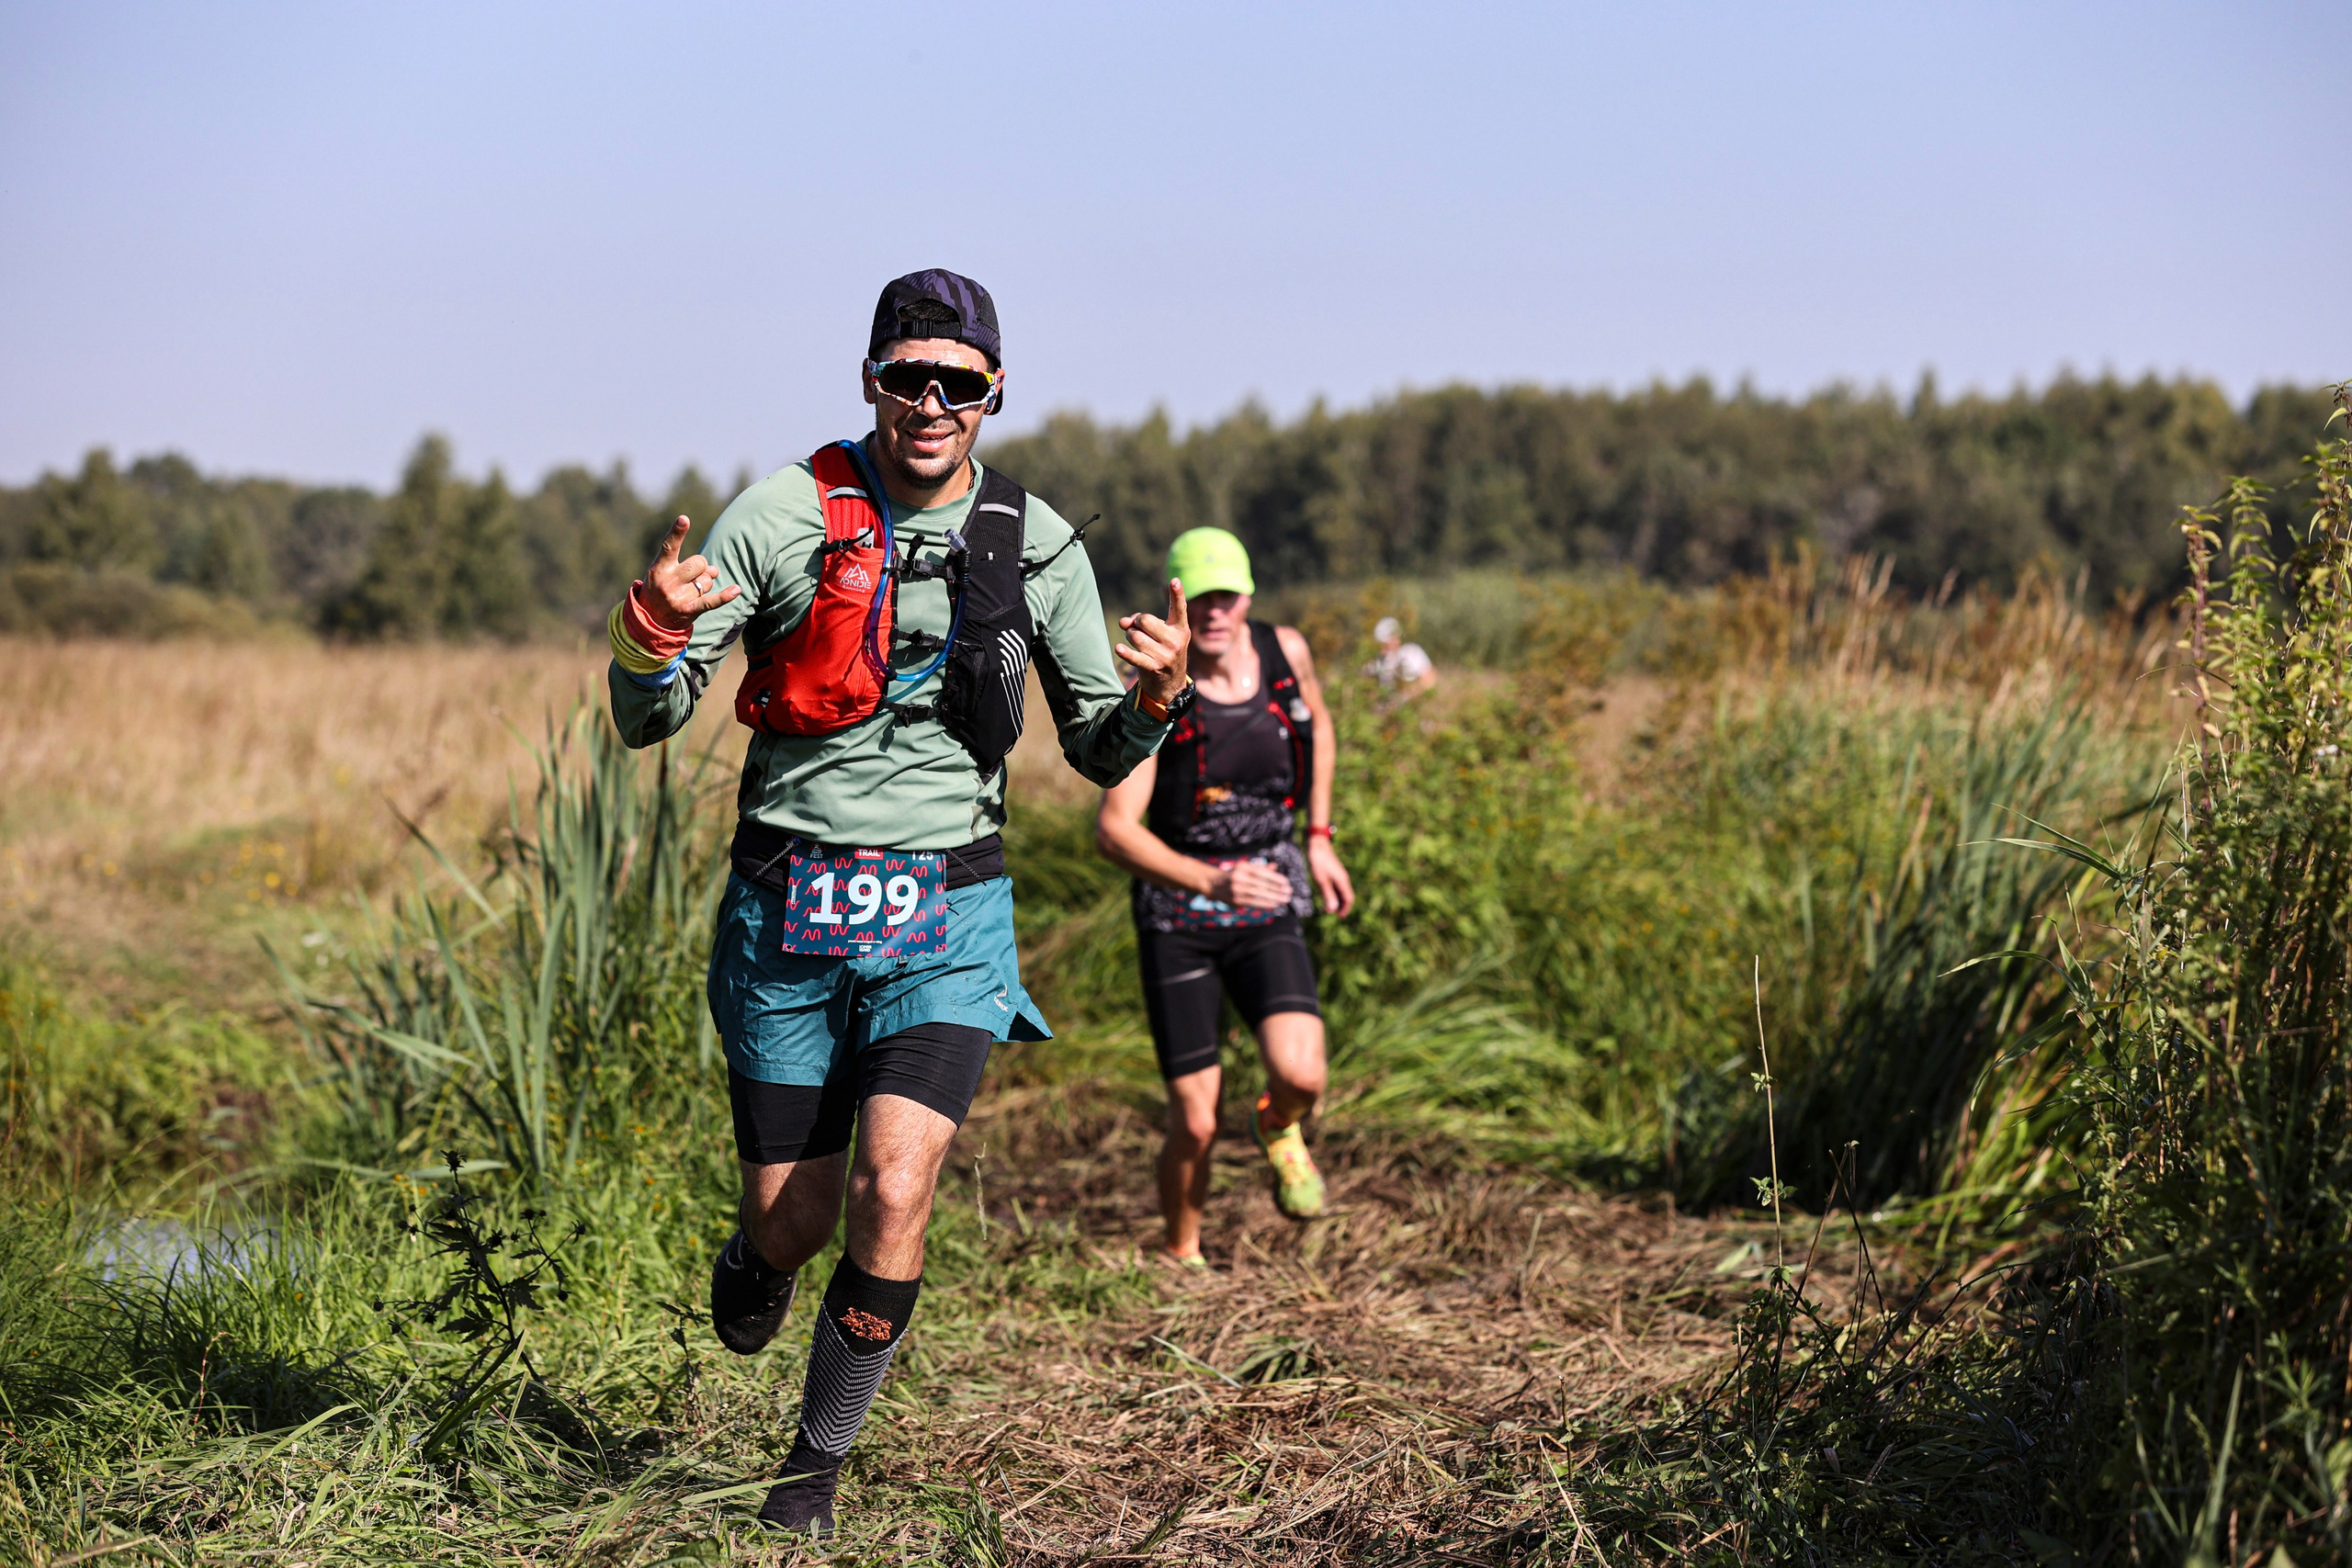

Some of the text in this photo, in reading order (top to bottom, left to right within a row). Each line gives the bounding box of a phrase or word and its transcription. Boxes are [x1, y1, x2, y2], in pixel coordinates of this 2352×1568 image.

[840, 577, 872, 590] AONIJE
[858, 849, 881, 857] TRAIL
[809, 872, 920, 926] 199
